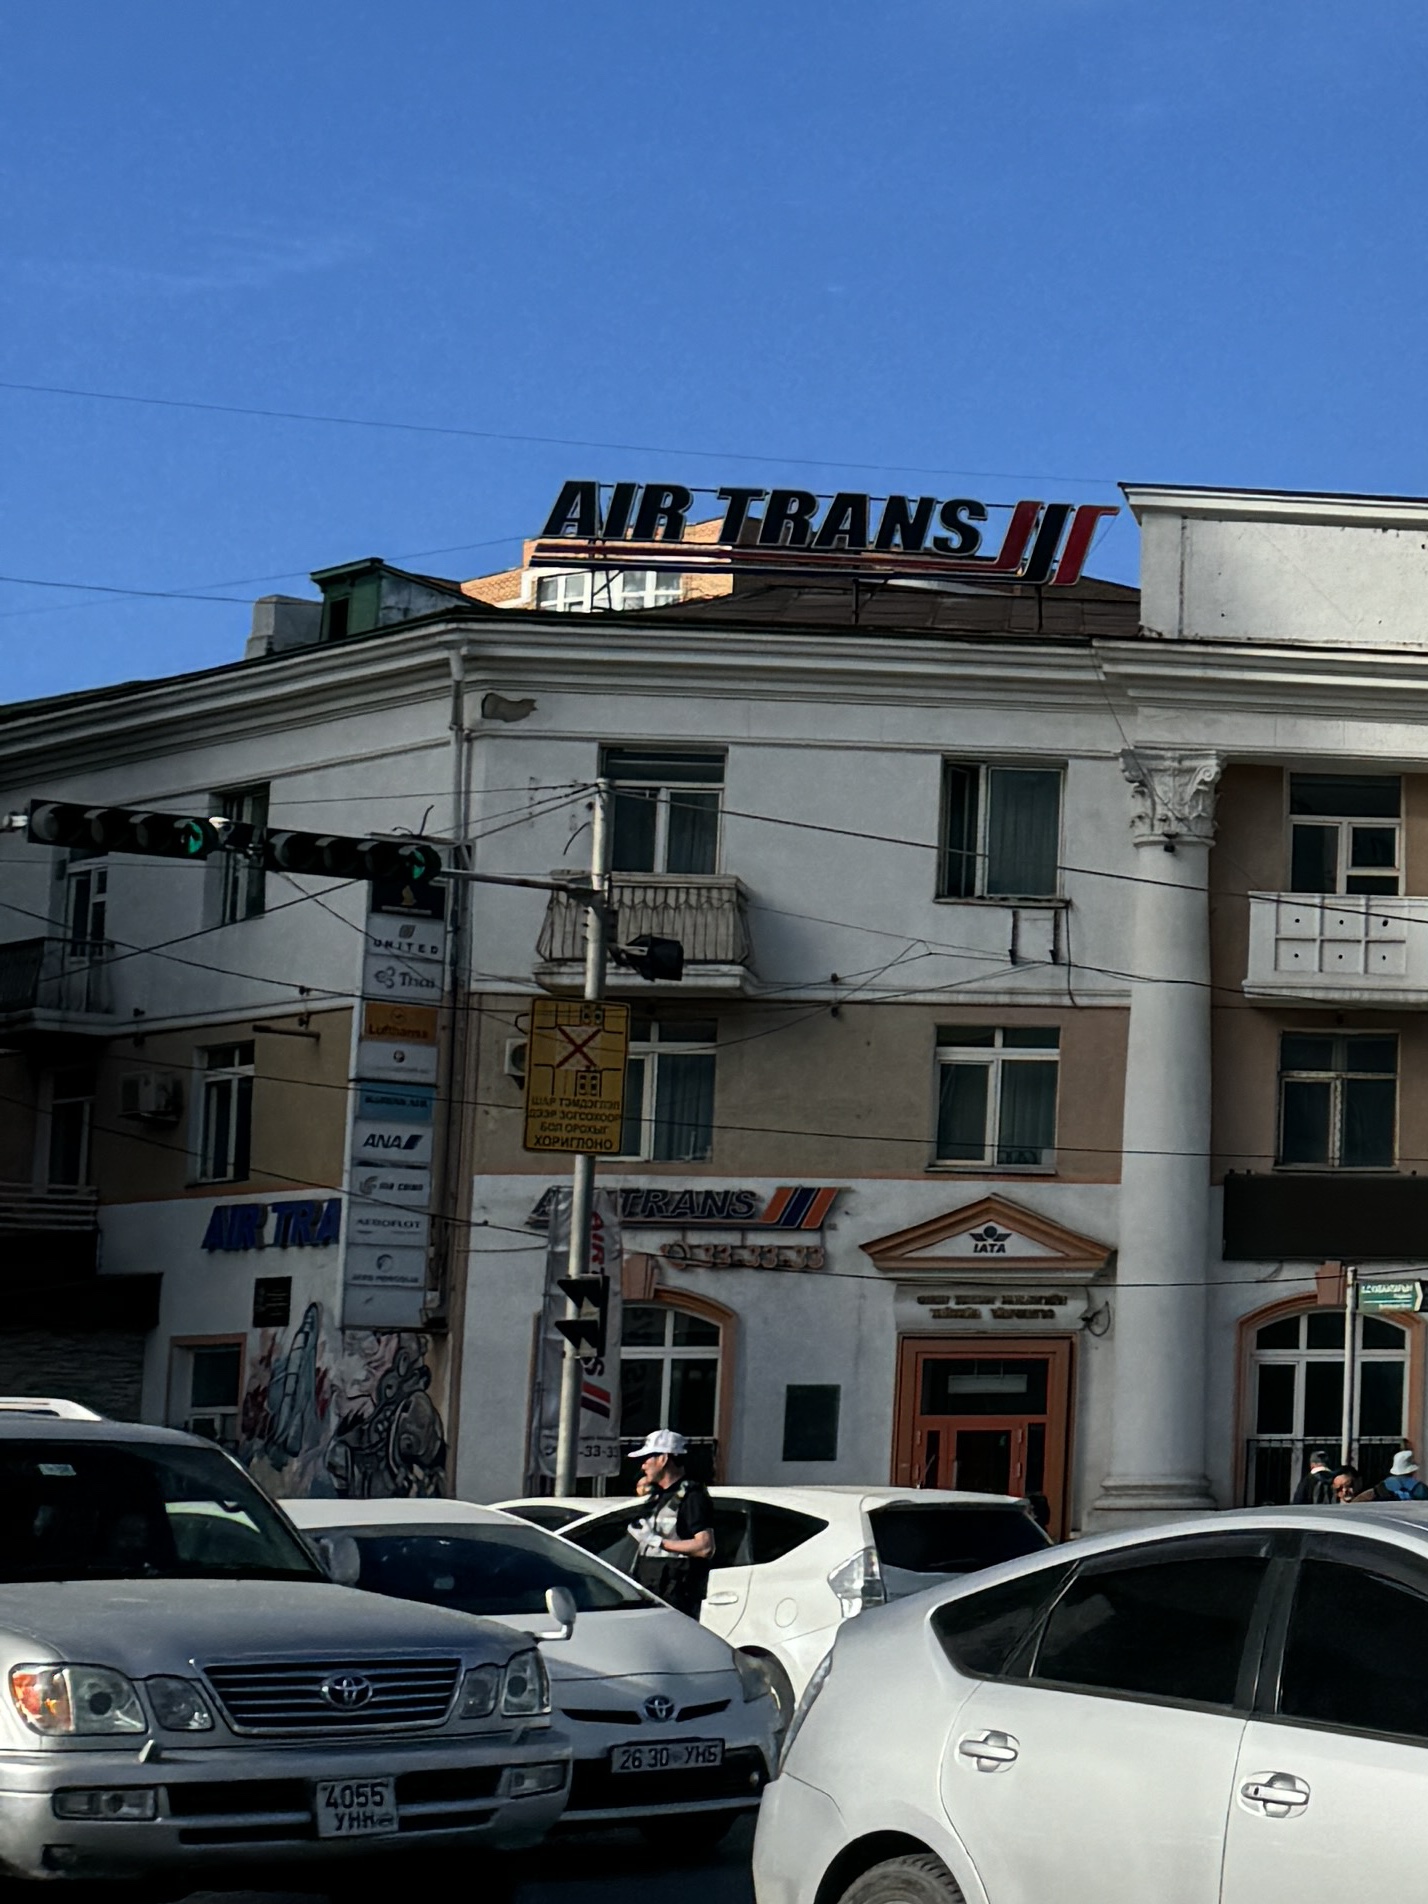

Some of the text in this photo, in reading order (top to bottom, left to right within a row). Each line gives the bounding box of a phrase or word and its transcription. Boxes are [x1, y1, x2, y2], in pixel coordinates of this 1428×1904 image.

[541, 481, 989, 556] AIR TRANS
[373, 939, 439, 955] UNITED
[399, 970, 436, 989] Thai
[531, 1096, 557, 1106] ШАР
[363, 1134, 402, 1149] ANA
[534, 1135, 613, 1151] ХОРИГЛОНО
[621, 1188, 757, 1219] TRANS
[201, 1198, 342, 1250] AIR TRA
[356, 1217, 422, 1229] AEROFLOT
[973, 1243, 1006, 1254] IATA
[325, 1782, 388, 1809] 4055
